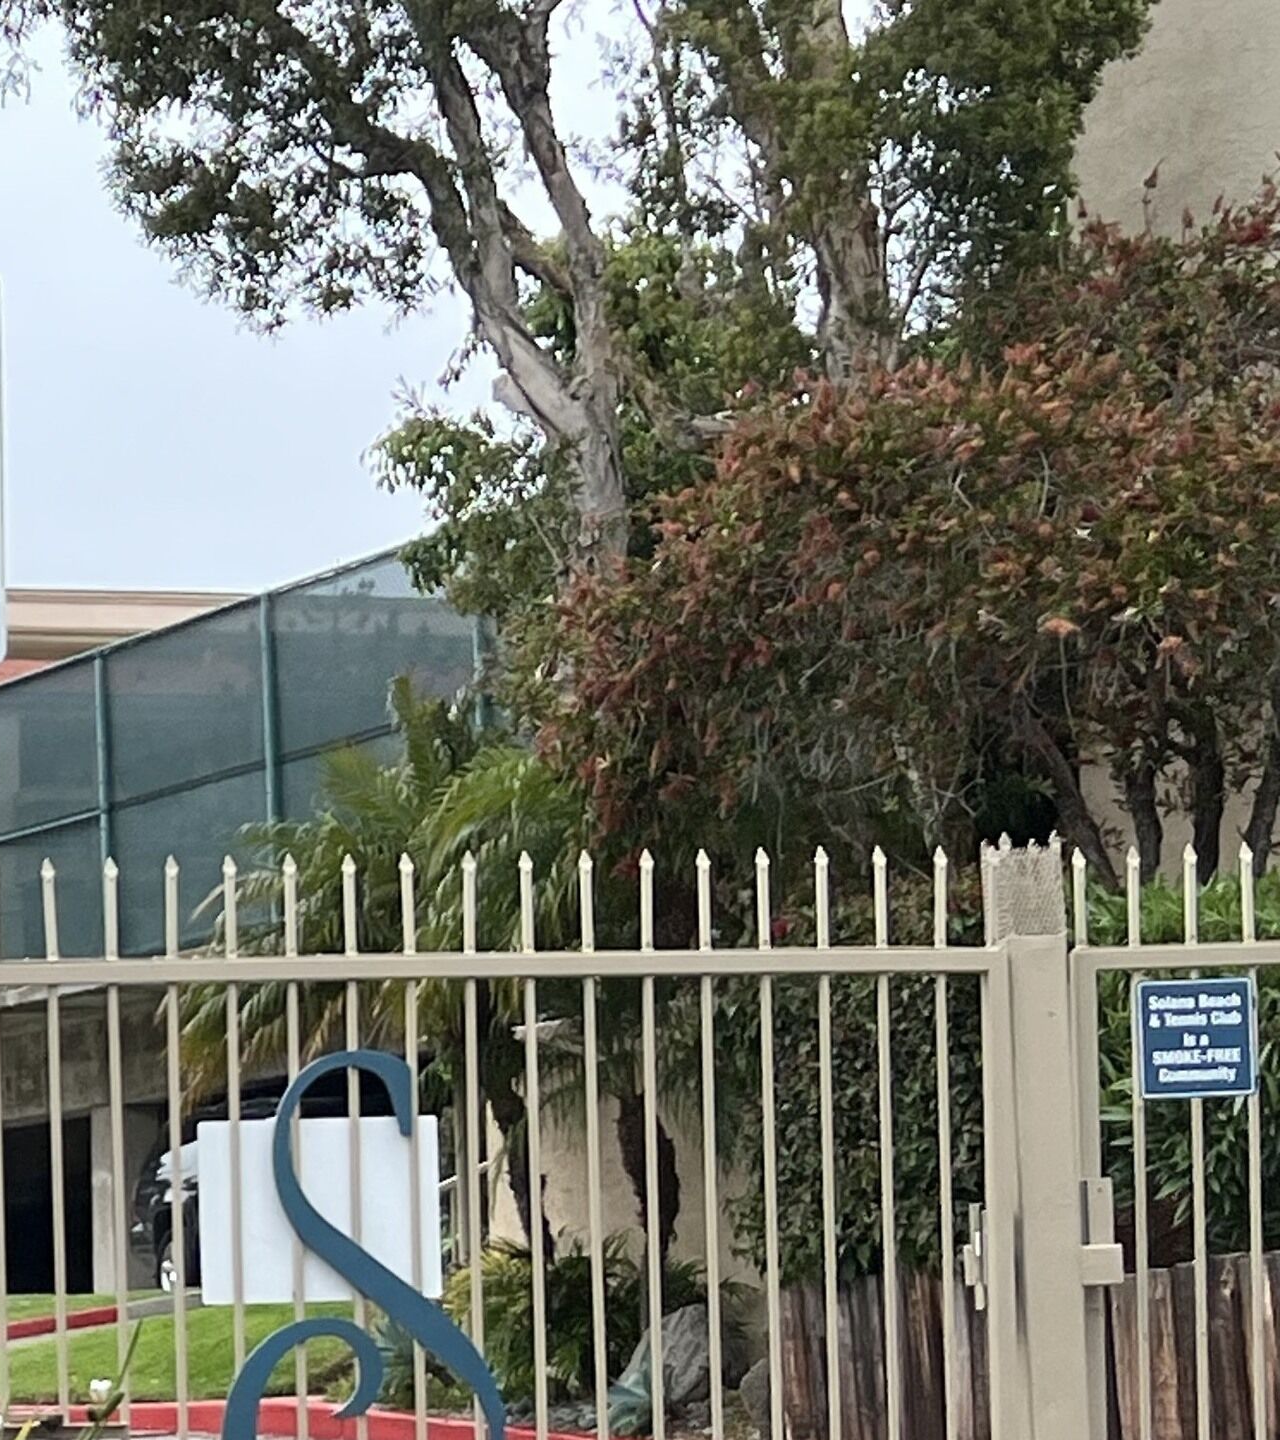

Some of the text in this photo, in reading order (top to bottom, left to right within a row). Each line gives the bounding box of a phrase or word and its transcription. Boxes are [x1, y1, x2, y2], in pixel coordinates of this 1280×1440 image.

[1198, 993, 1241, 1008] Beach
[1148, 1015, 1160, 1028] &
[1199, 1035, 1209, 1046] a
[1152, 1048, 1241, 1065] SMOKE-FREE
